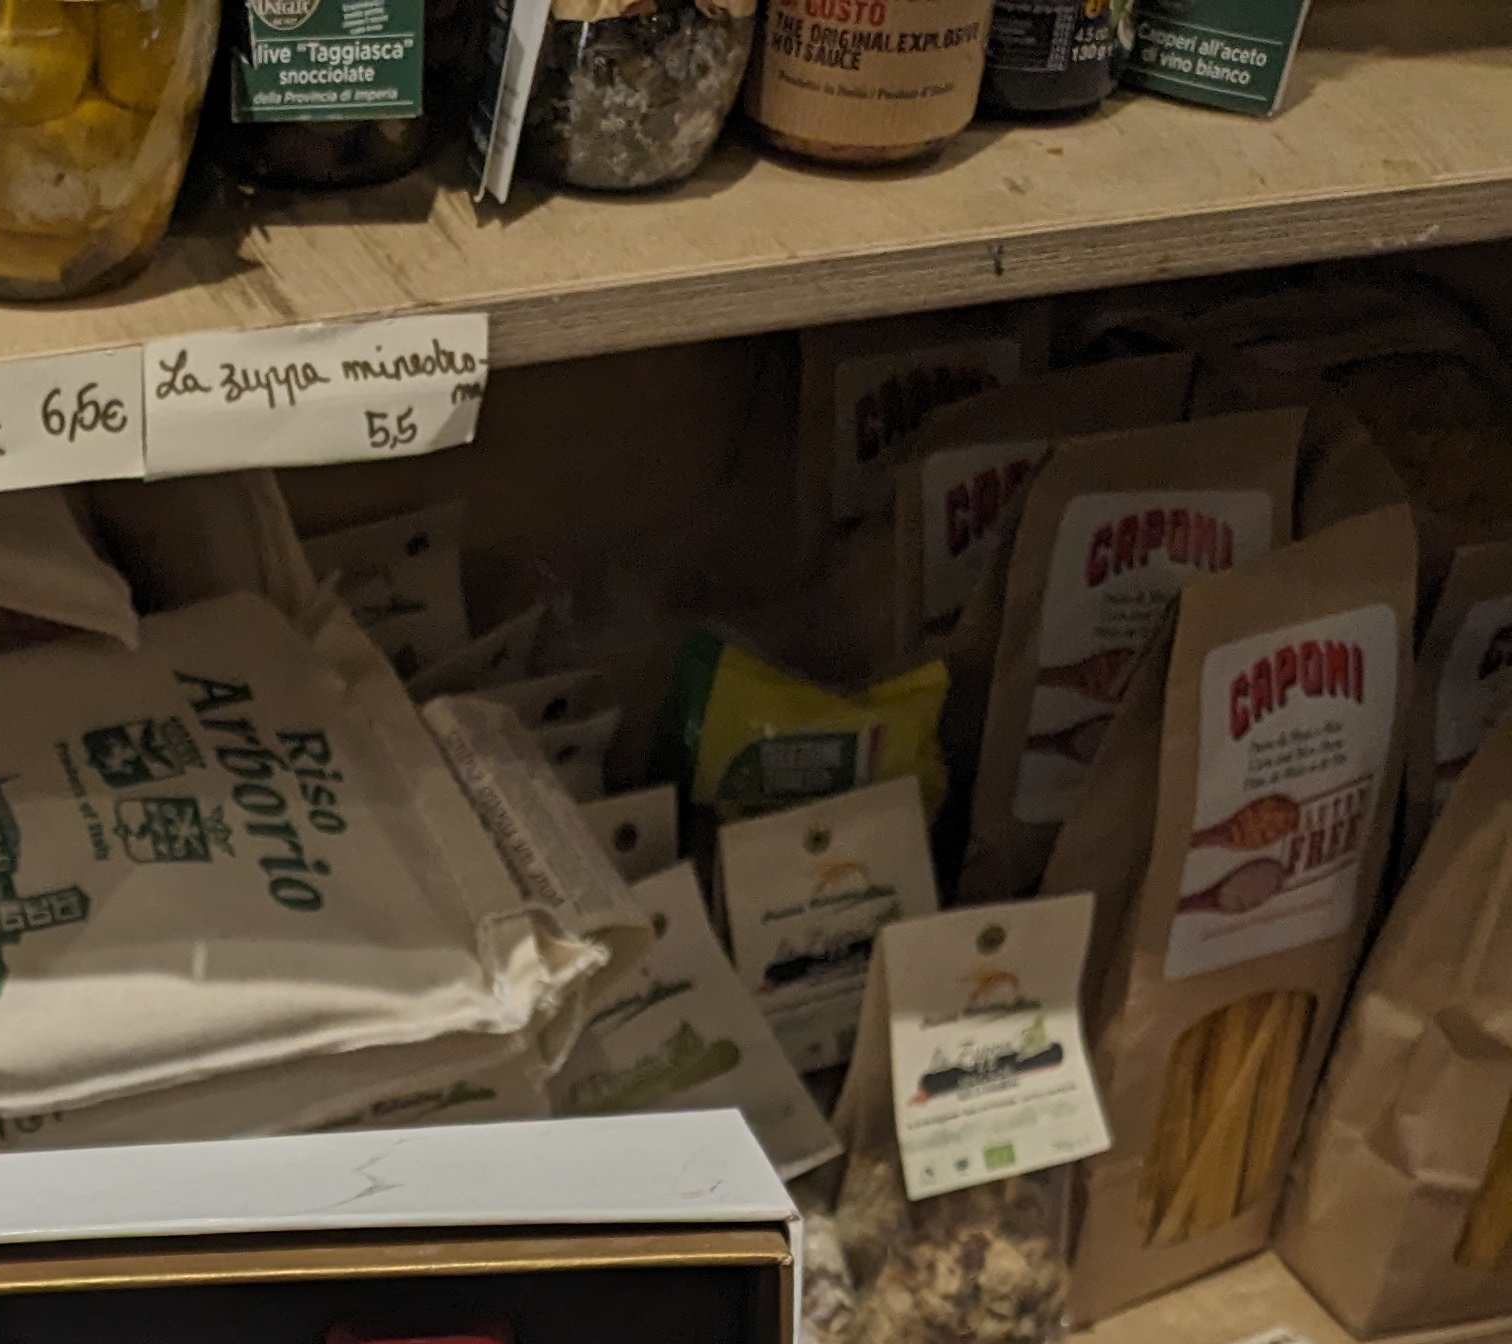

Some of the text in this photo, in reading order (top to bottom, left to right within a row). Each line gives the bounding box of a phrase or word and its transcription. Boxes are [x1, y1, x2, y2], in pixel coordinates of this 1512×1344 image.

[254, 39, 414, 66] live "Taggiasca"
[279, 66, 375, 85] snocciolate
[1195, 60, 1252, 85] bianco
[364, 408, 418, 451] 5,5
[1085, 508, 1234, 588] CAPONI
[1230, 640, 1364, 741] CAPONI
[173, 668, 326, 914] Arborio
[276, 727, 350, 835] Riso
